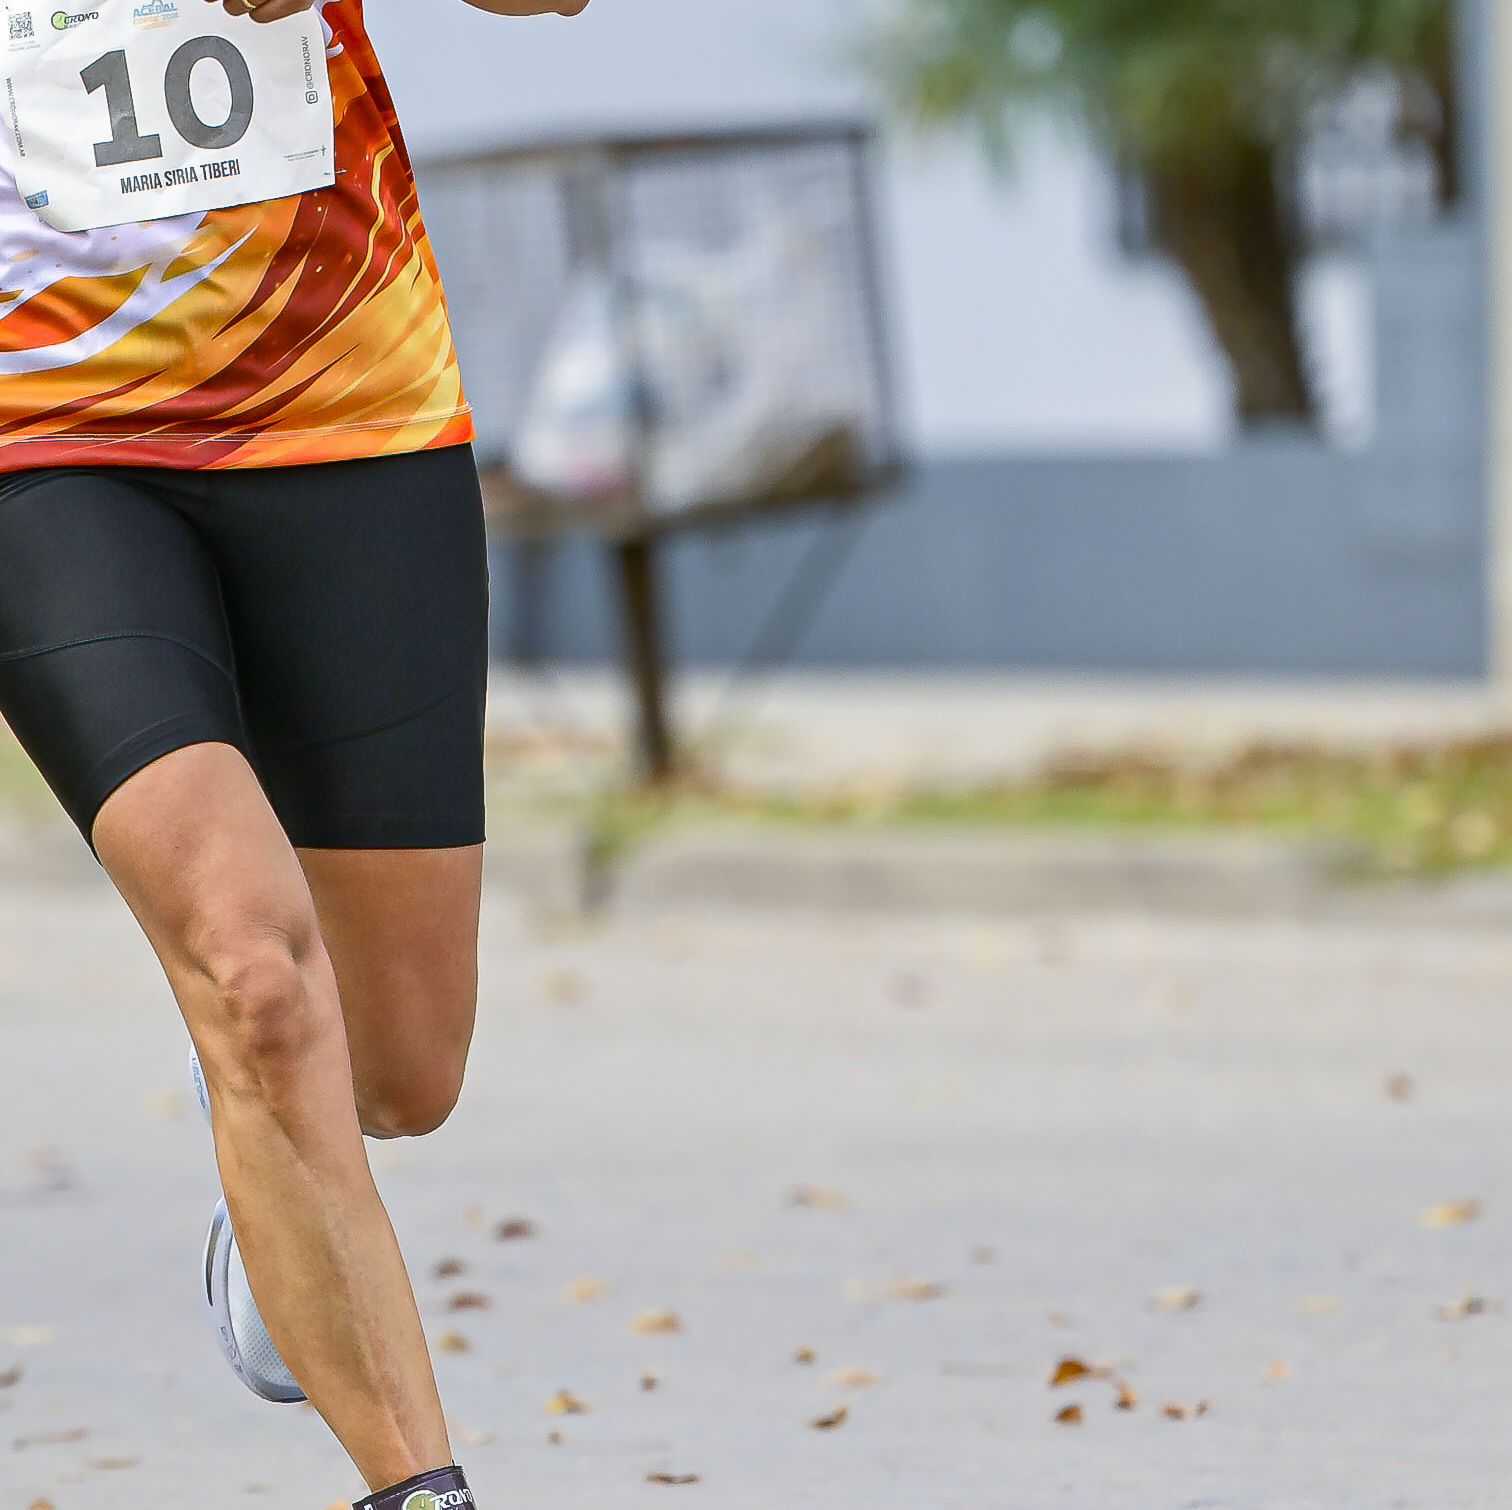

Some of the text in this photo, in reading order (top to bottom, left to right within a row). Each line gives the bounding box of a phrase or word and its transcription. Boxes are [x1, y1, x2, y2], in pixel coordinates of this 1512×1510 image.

[79, 35, 254, 168] 10
[120, 158, 241, 194] MARIA SIRIA TIBERI
